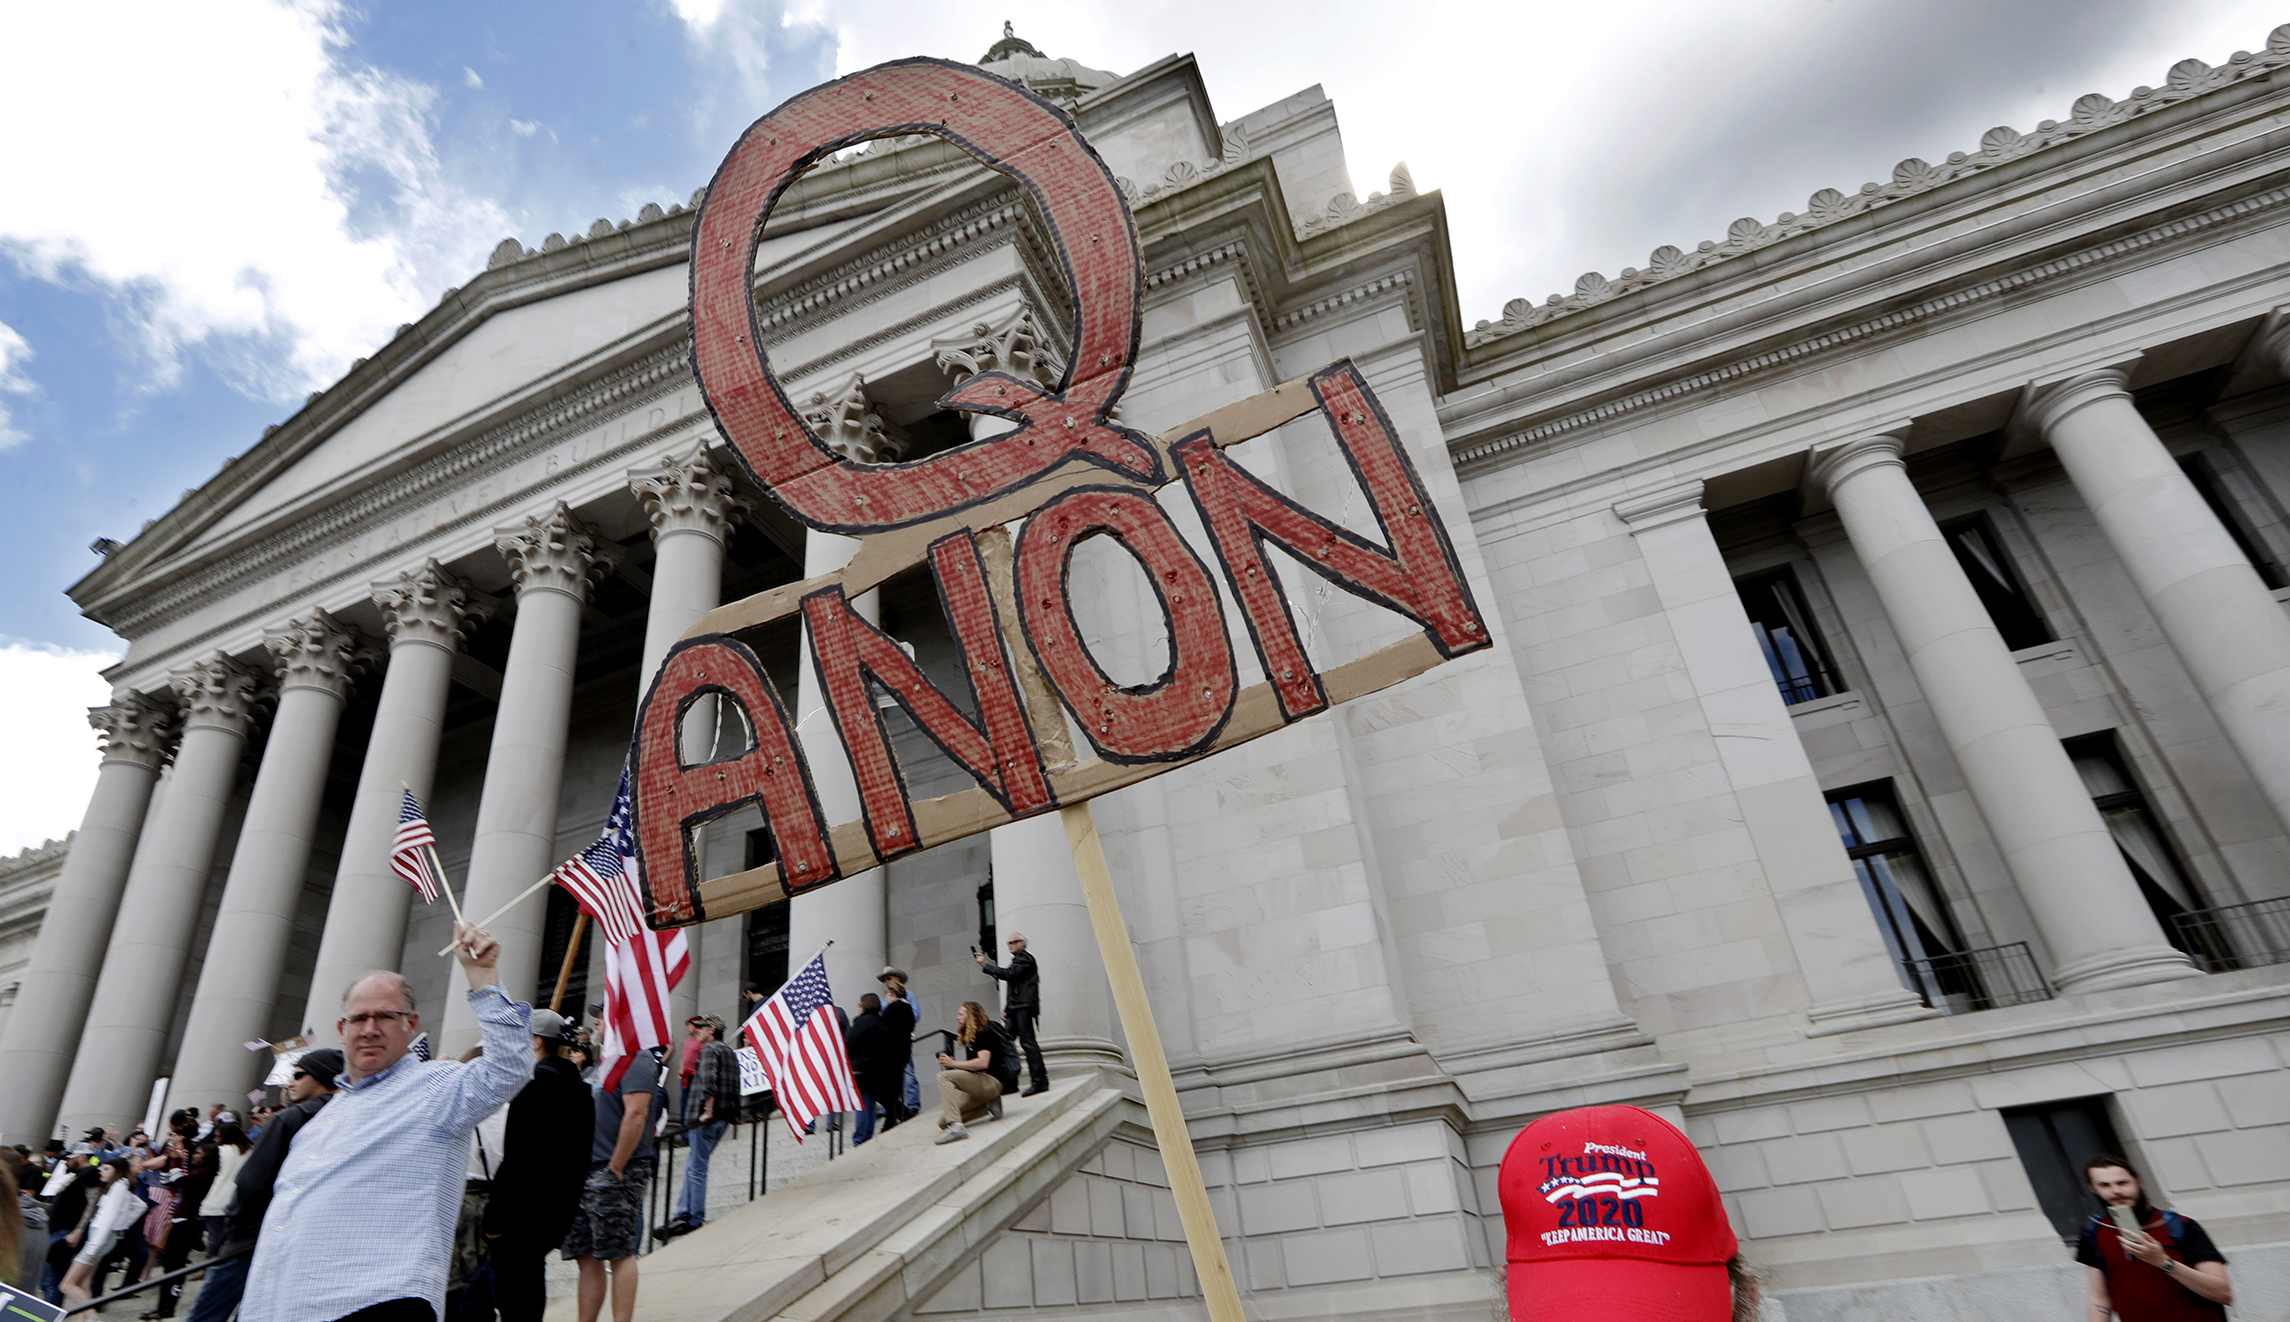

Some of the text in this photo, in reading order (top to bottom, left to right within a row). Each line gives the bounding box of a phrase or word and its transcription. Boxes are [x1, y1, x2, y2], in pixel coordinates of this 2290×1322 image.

[688, 56, 1168, 535] Q
[544, 388, 703, 476] BUILDI
[631, 357, 1493, 930] ANON
[1539, 1153, 1655, 1186] Trump
[1584, 1141, 1647, 1161] President
[1557, 1197, 1643, 1228] 2020
